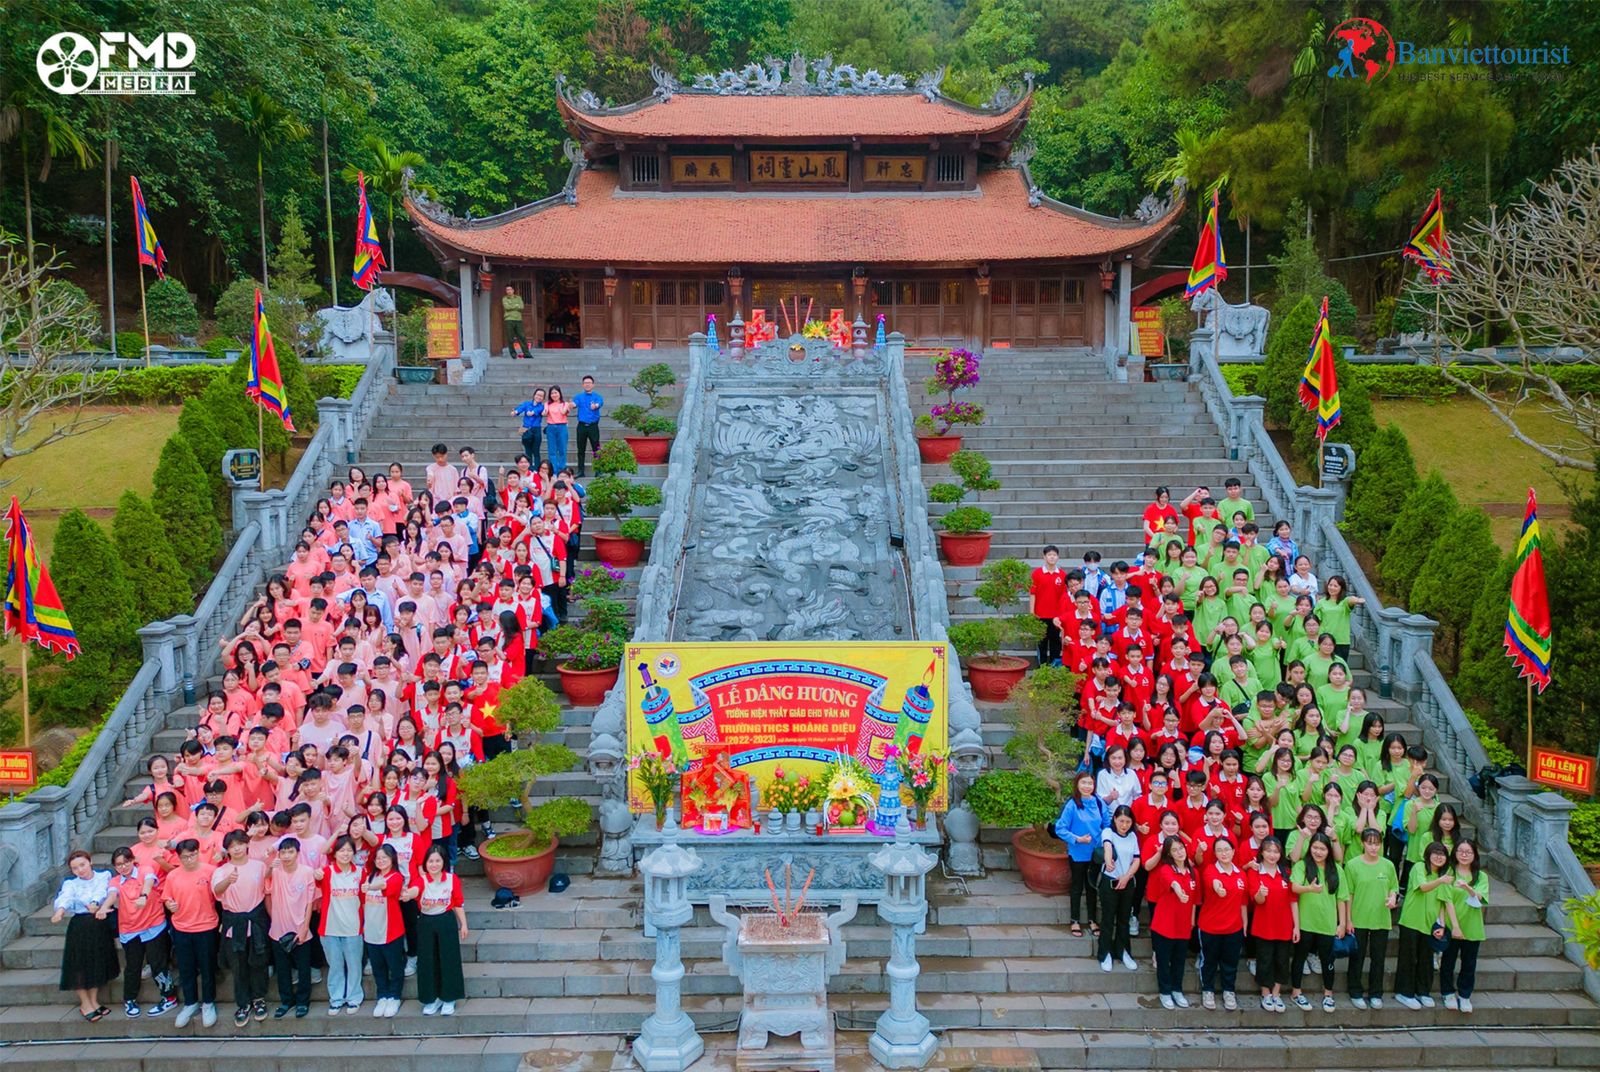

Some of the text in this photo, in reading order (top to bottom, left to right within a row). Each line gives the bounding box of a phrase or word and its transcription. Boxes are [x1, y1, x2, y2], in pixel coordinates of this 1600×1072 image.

[717, 682, 859, 708] LỄ DÂNG HƯƠNG
[719, 721, 856, 736] TRƯỜNG THCS HOÀNG DIỆU
[725, 734, 776, 744] (2022-2023)
[1558, 759, 1576, 773] LÊN
